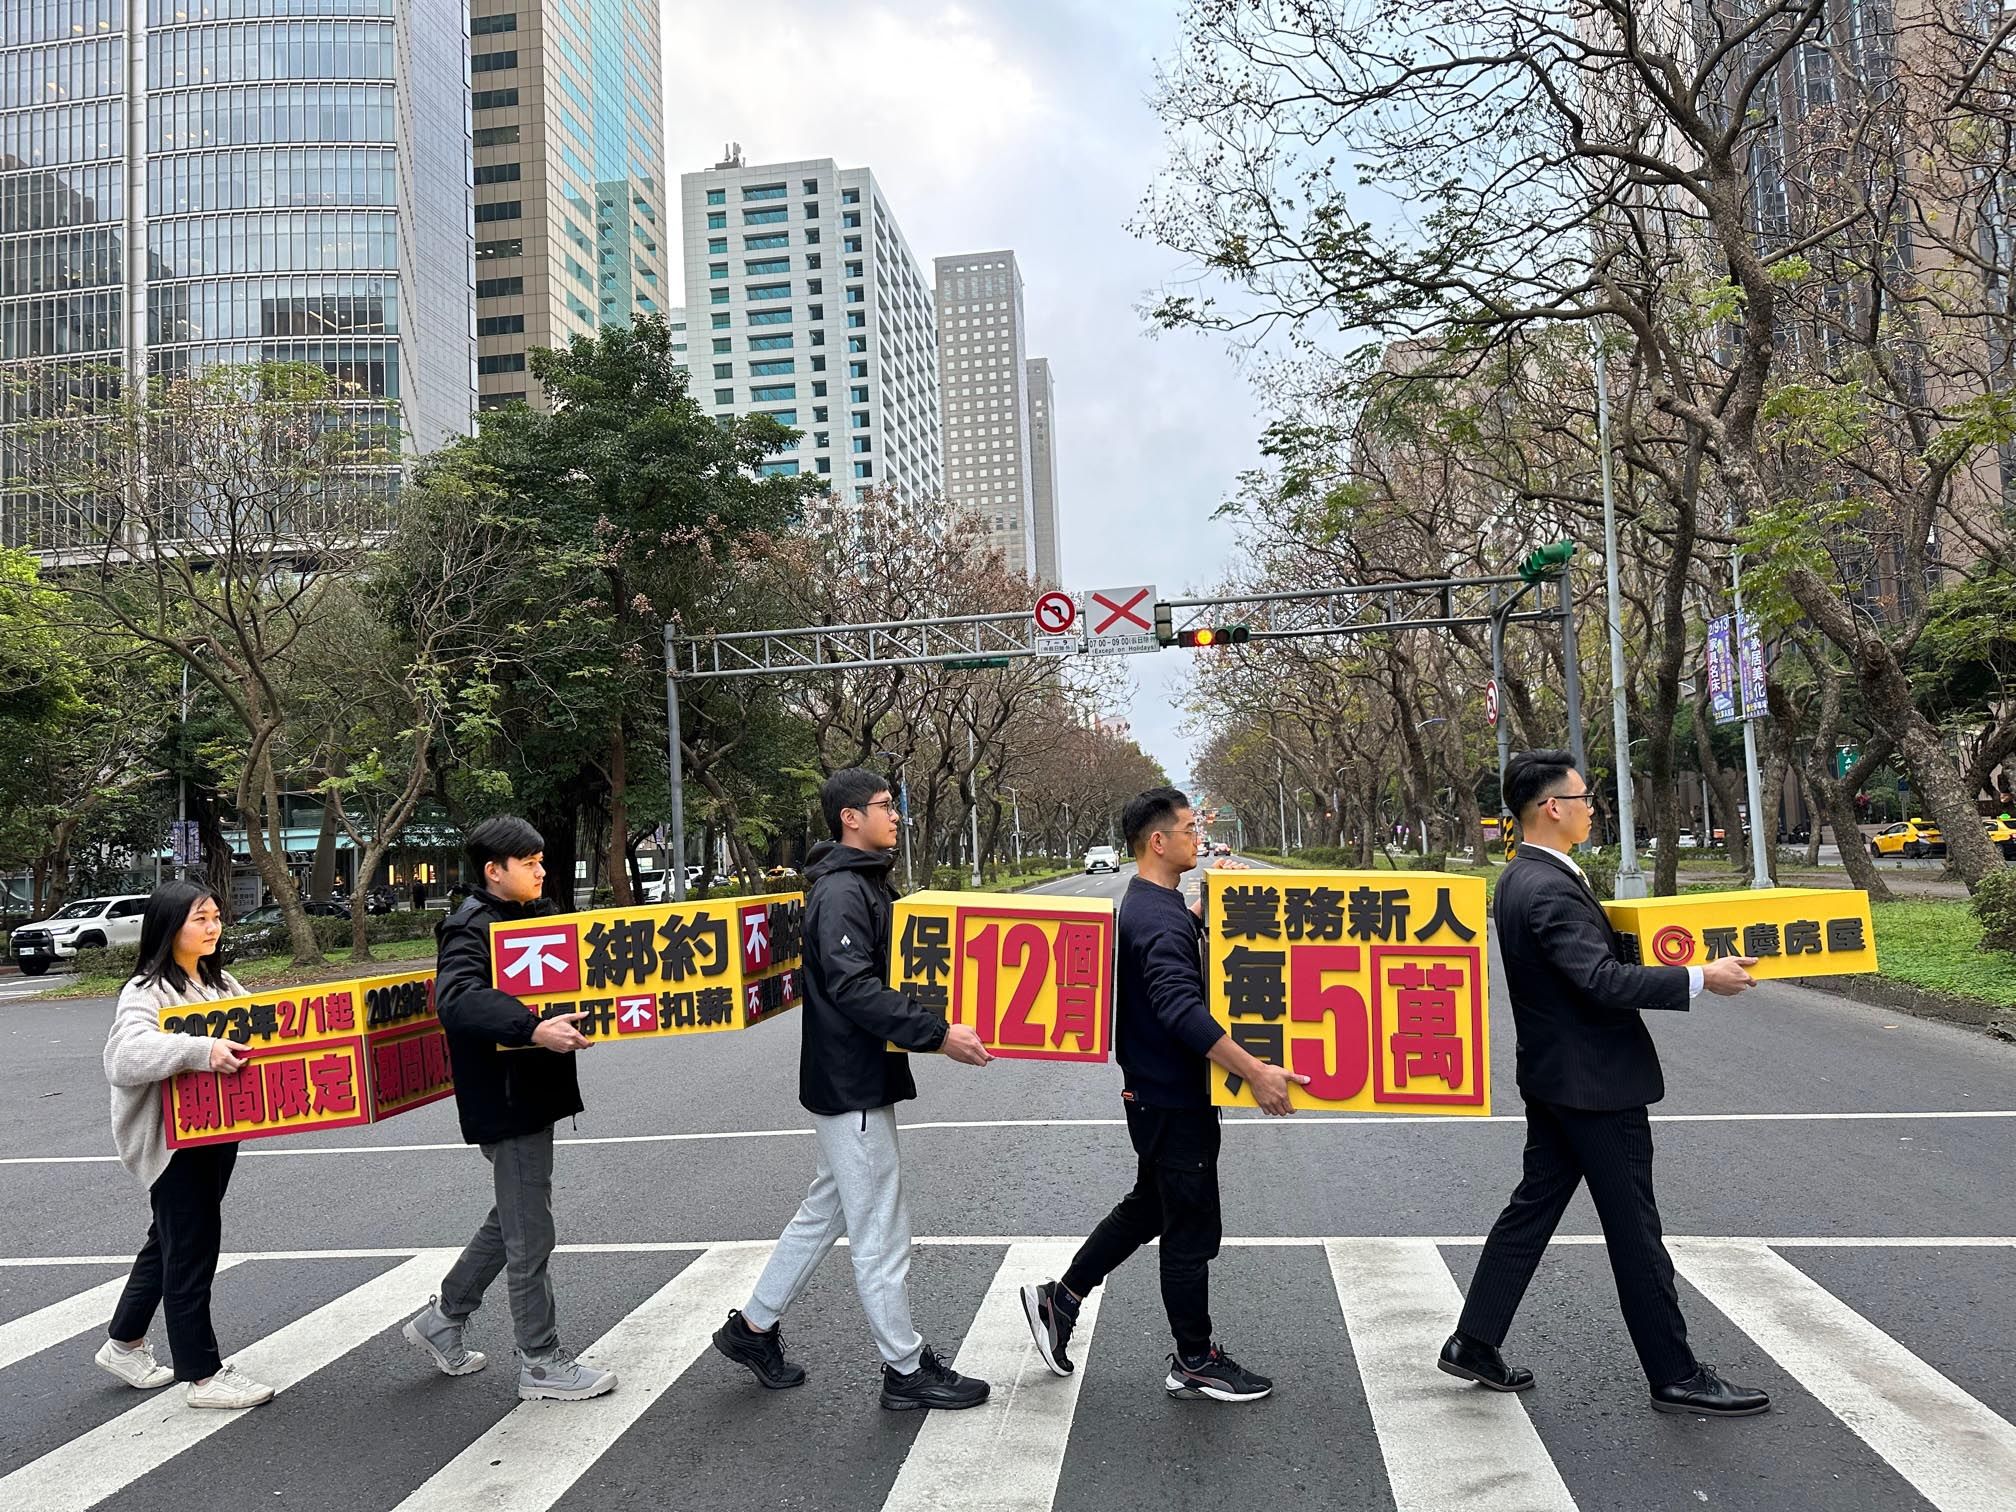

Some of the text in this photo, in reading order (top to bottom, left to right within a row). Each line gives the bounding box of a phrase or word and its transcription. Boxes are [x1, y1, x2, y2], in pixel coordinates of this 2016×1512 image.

[1709, 637, 1721, 692] 家具名床
[1750, 637, 1765, 698] 家居美化
[1221, 886, 1476, 942] 業務新人
[1702, 917, 1866, 960] 永慶房屋
[502, 912, 728, 988] 不綁約
[541, 986, 733, 1035] 肝不扣薪
[1291, 945, 1369, 1100] 5
[1388, 963, 1464, 1089] 萬
[177, 1054, 356, 1132] 期間限定
